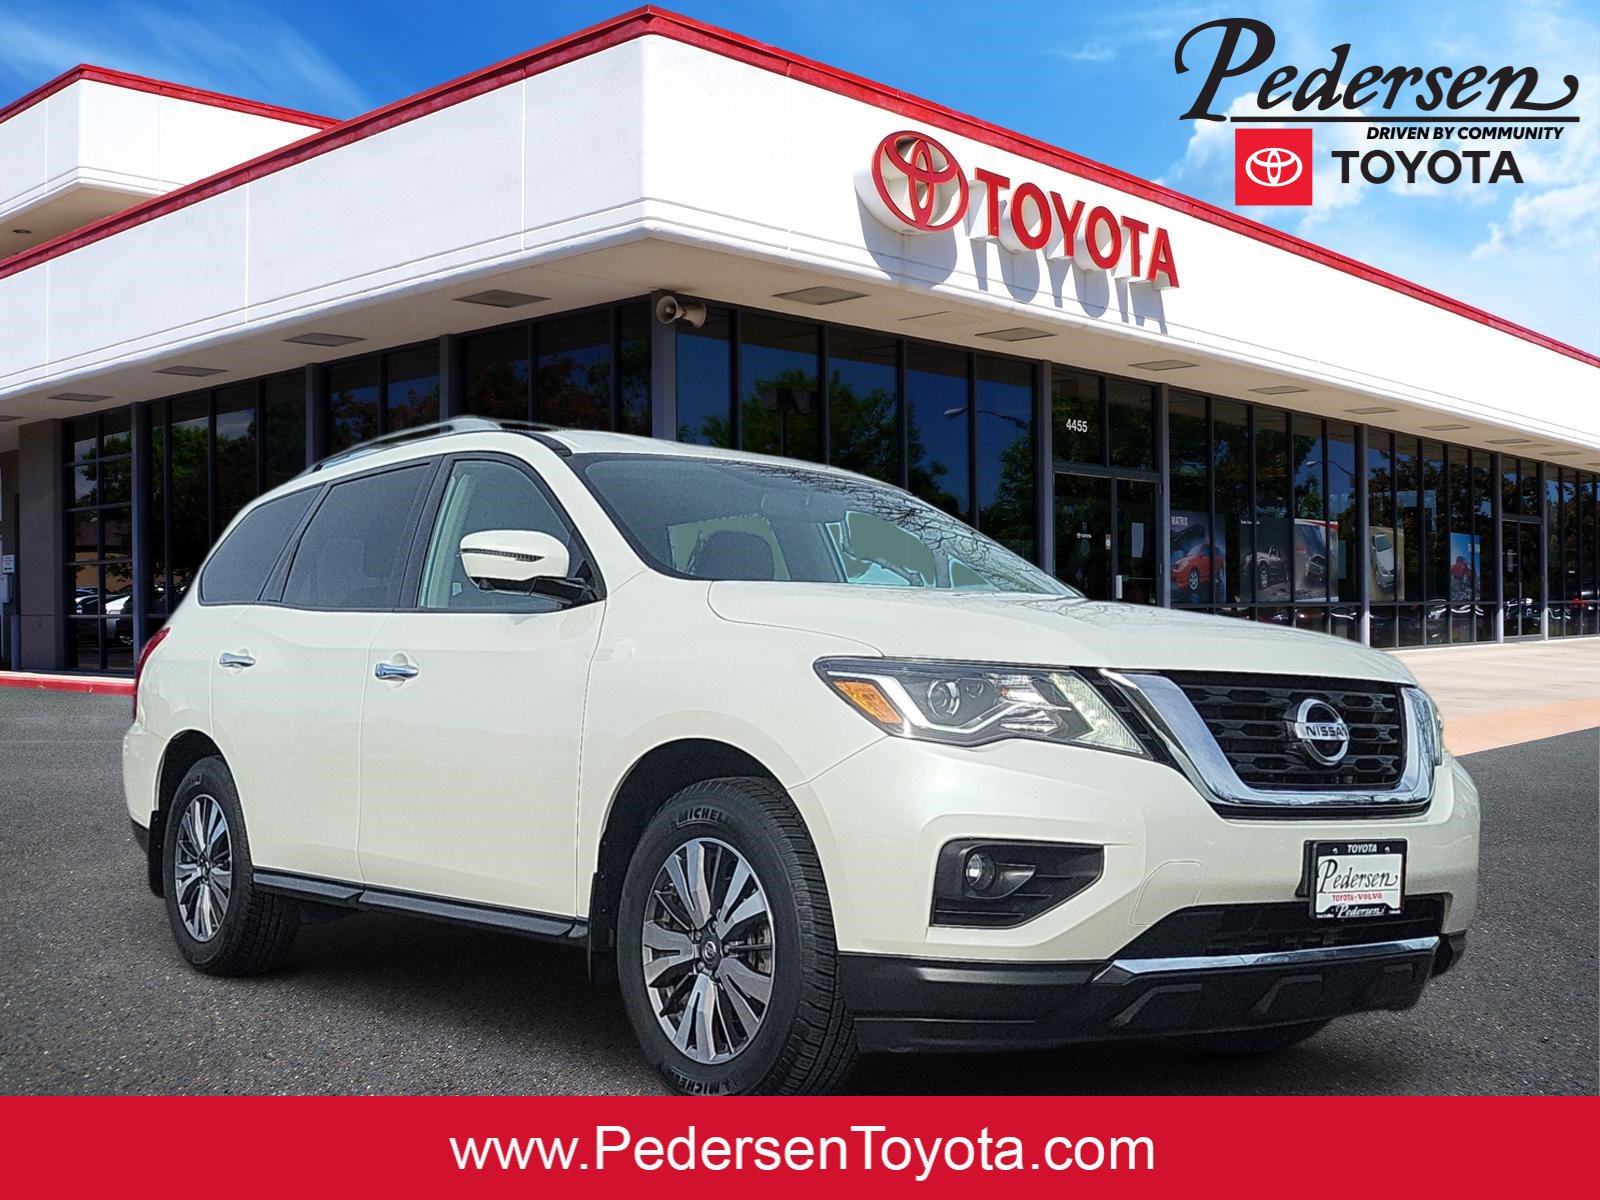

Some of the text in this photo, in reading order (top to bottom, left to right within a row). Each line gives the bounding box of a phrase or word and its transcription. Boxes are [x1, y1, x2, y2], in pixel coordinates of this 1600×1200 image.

[974, 166, 1180, 289] TOYOTA
[1065, 418, 1088, 433] 4455
[1346, 844, 1378, 854] TOYOTA
[1317, 859, 1398, 894] Pedersen
[1336, 904, 1385, 918] Pedersen
